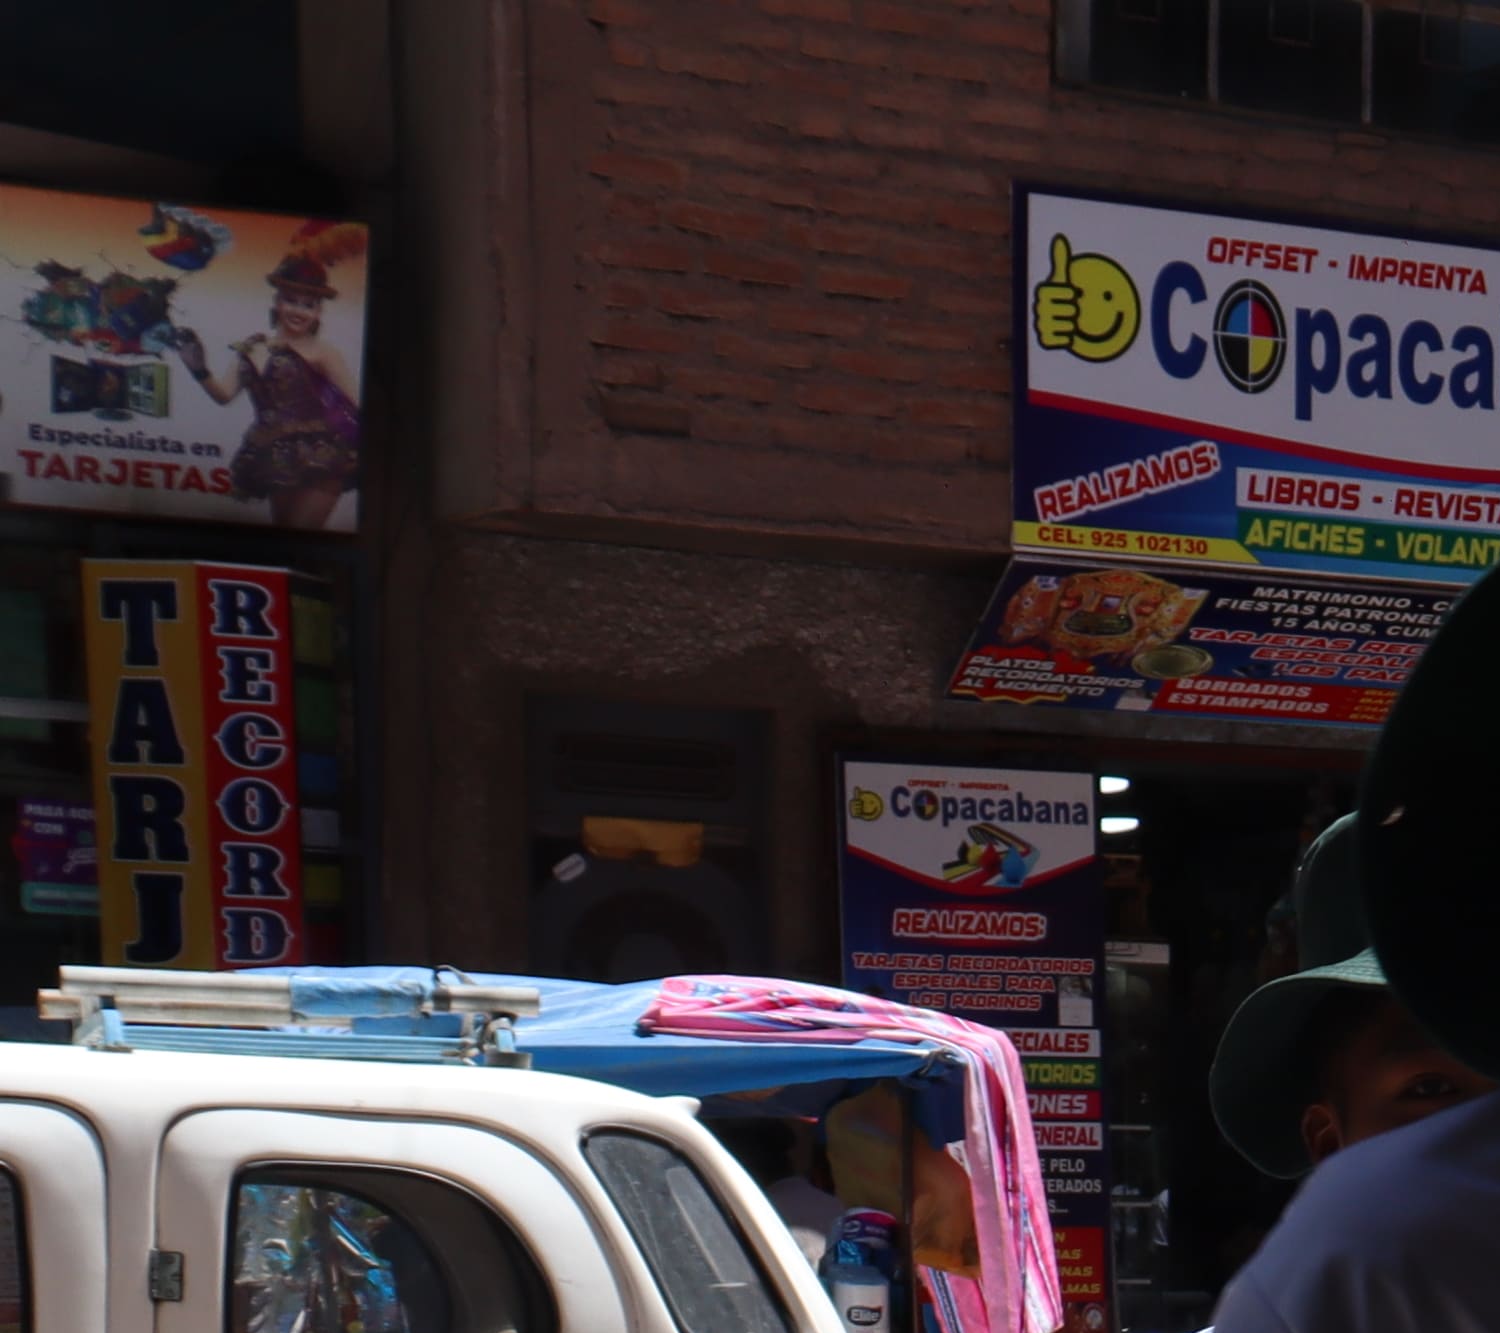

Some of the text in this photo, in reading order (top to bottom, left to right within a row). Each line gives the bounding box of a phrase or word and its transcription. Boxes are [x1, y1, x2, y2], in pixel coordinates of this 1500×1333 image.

[1206, 237, 1319, 275] OFFSET
[1348, 254, 1488, 295] IMPRENTA
[28, 422, 222, 458] Especialista en
[17, 449, 233, 495] TARJETAS
[1034, 441, 1223, 524] REALIZAMOS:
[1248, 475, 1360, 510] LIBROS
[1037, 527, 1208, 555] CEL: 925 102130
[1243, 517, 1366, 555] AFICHES
[1215, 599, 1318, 616] FIESTAS
[1252, 586, 1412, 609] MATRIMONIO
[1271, 616, 1297, 628] 15
[1188, 626, 1356, 650] TARJETAS
[967, 655, 1057, 671] PLATOS
[957, 677, 1108, 697] AL MOMENTO
[962, 665, 1145, 689] RECORDATORIOS
[1175, 677, 1312, 699] BORDADOS
[1167, 693, 1330, 714] ESTAMPADOS
[891, 785, 1089, 827] Copacabana
[894, 910, 1047, 940] REALIZAMOS:
[853, 953, 1095, 974] TARJETAS RECORDATORIOS
[893, 974, 1056, 992] ESPECIALES PARA
[951, 995, 1042, 1011] PADRINOS
[1050, 1158, 1086, 1174] PELO
